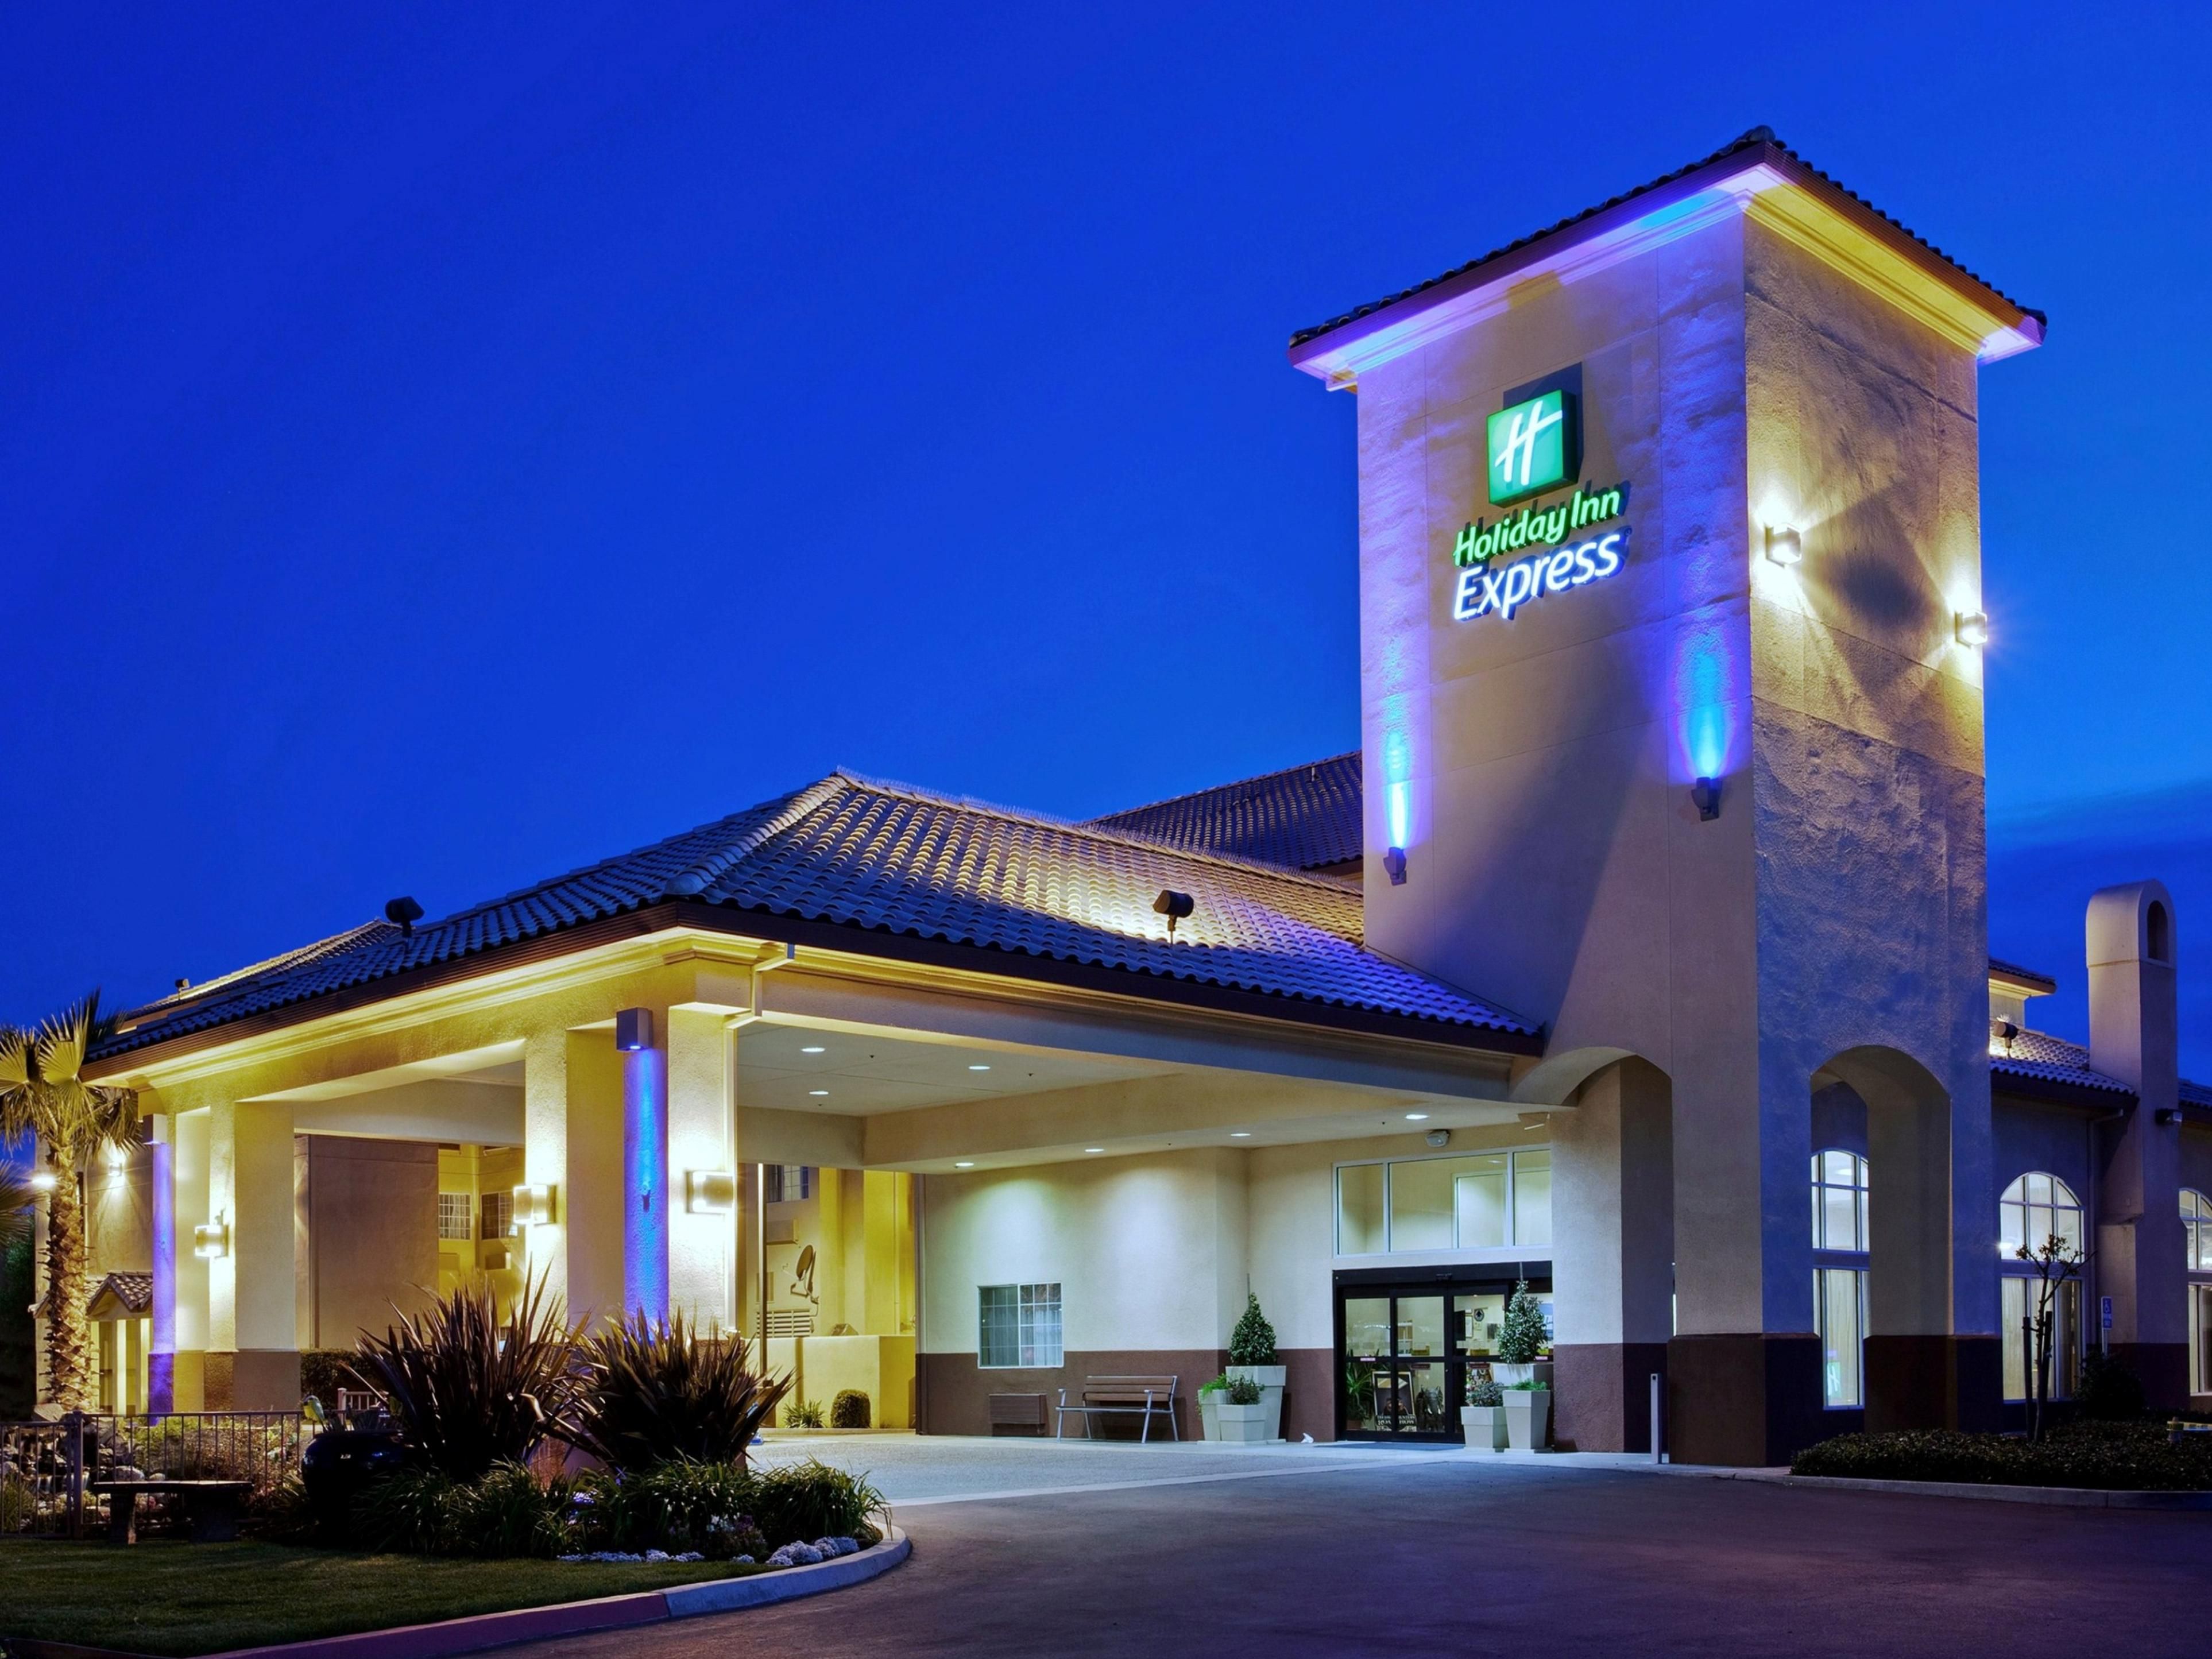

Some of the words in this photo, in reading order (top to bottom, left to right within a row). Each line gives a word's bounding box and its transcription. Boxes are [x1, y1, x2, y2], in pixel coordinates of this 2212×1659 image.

[1453, 506, 1567, 567] Holiday
[1571, 489, 1621, 528] Inn
[1453, 534, 1621, 620] Express
